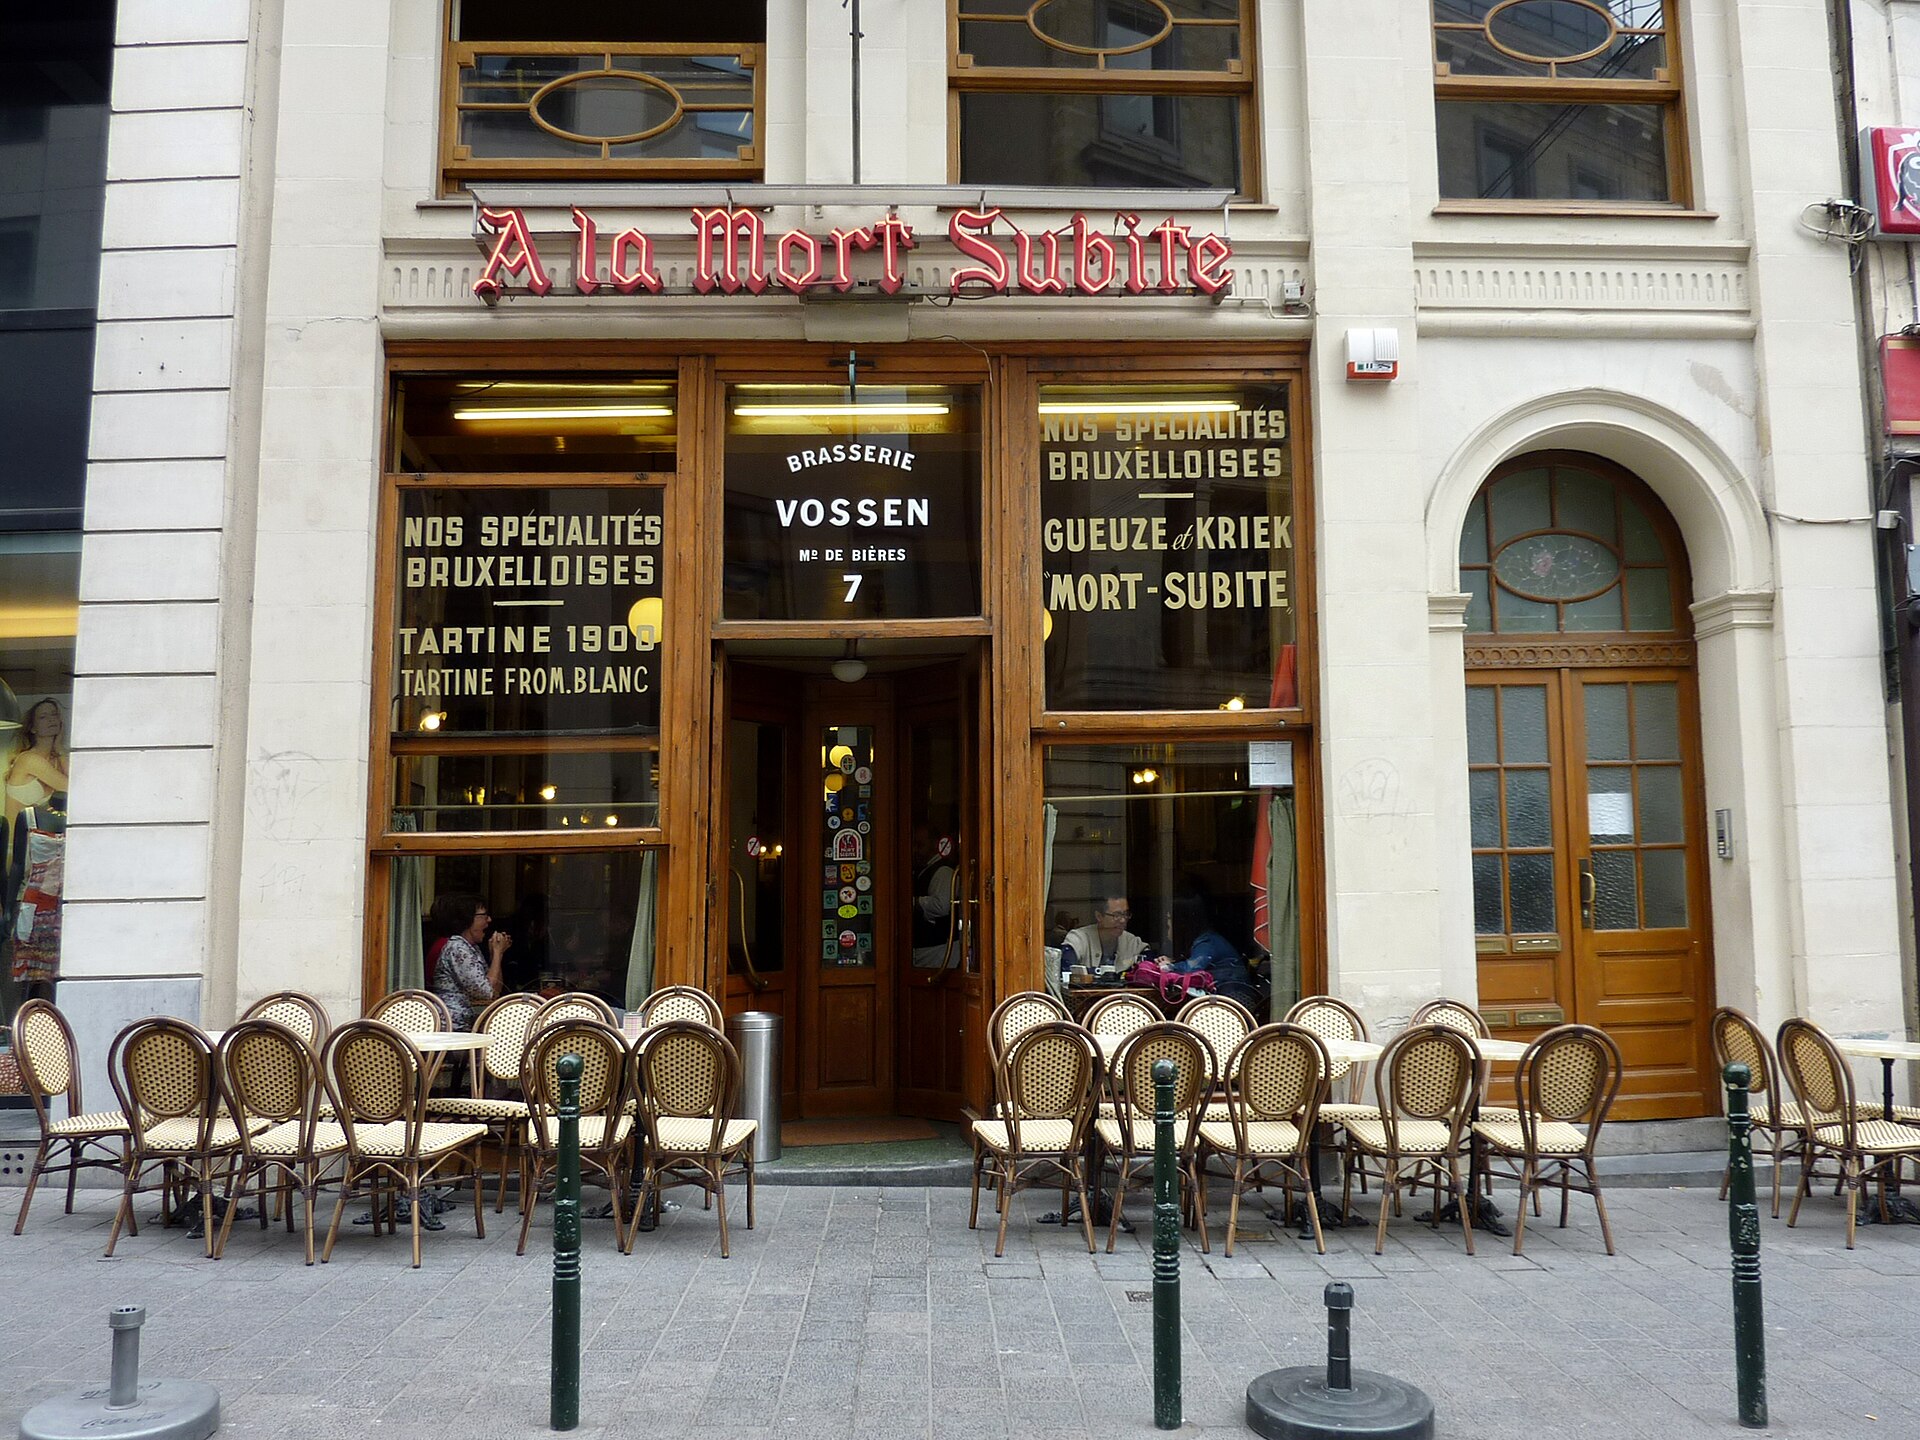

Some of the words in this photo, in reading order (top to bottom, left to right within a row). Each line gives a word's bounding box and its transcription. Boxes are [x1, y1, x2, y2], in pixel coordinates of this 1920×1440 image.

[472, 207, 552, 304] A
[570, 204, 663, 295] la
[690, 207, 913, 296] Mort
[949, 206, 1233, 296] Subite
[1043, 411, 1098, 442] NOS
[786, 444, 916, 473] BRASSERIE
[1048, 447, 1282, 481] BRUXELLOISES
[404, 516, 463, 547] NOS
[480, 508, 662, 547] SPÉCIALITÉS
[775, 498, 929, 527] VOSSEN
[1044, 516, 1168, 552] GUEUZE
[1170, 523, 1194, 550] et
[1195, 515, 1293, 550] KRIEK
[825, 549, 844, 562] DE
[852, 545, 907, 562] BIÈRES
[406, 555, 655, 588] BRUXELLOISES
[842, 574, 863, 603] 7
[399, 625, 551, 655] TARTINE
[566, 624, 656, 652] 1900
[401, 667, 494, 697] TARTINE
